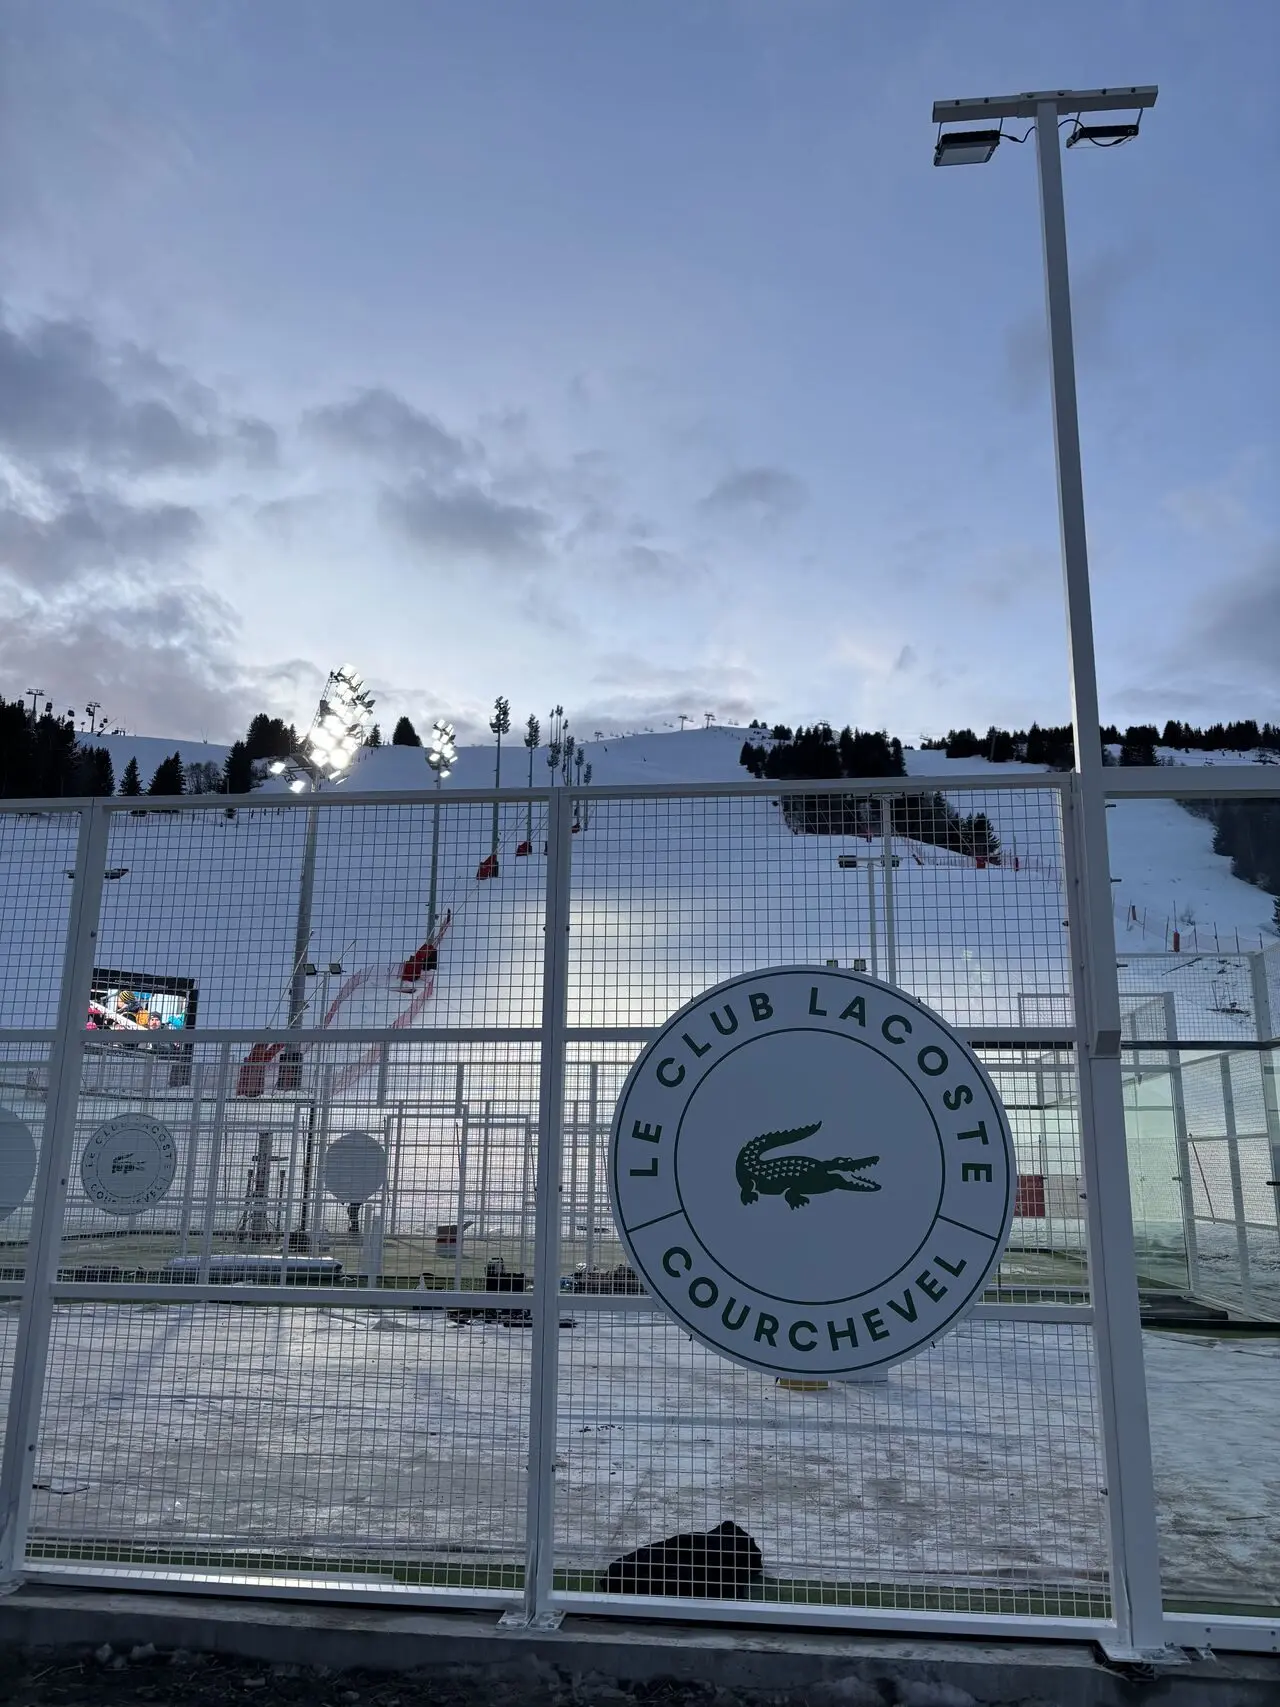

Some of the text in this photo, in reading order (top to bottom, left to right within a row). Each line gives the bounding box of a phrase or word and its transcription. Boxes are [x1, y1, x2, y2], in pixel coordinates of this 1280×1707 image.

[629, 987, 993, 1183] LE CLUB LACOSTE
[662, 1246, 968, 1352] COURCHEVEL
